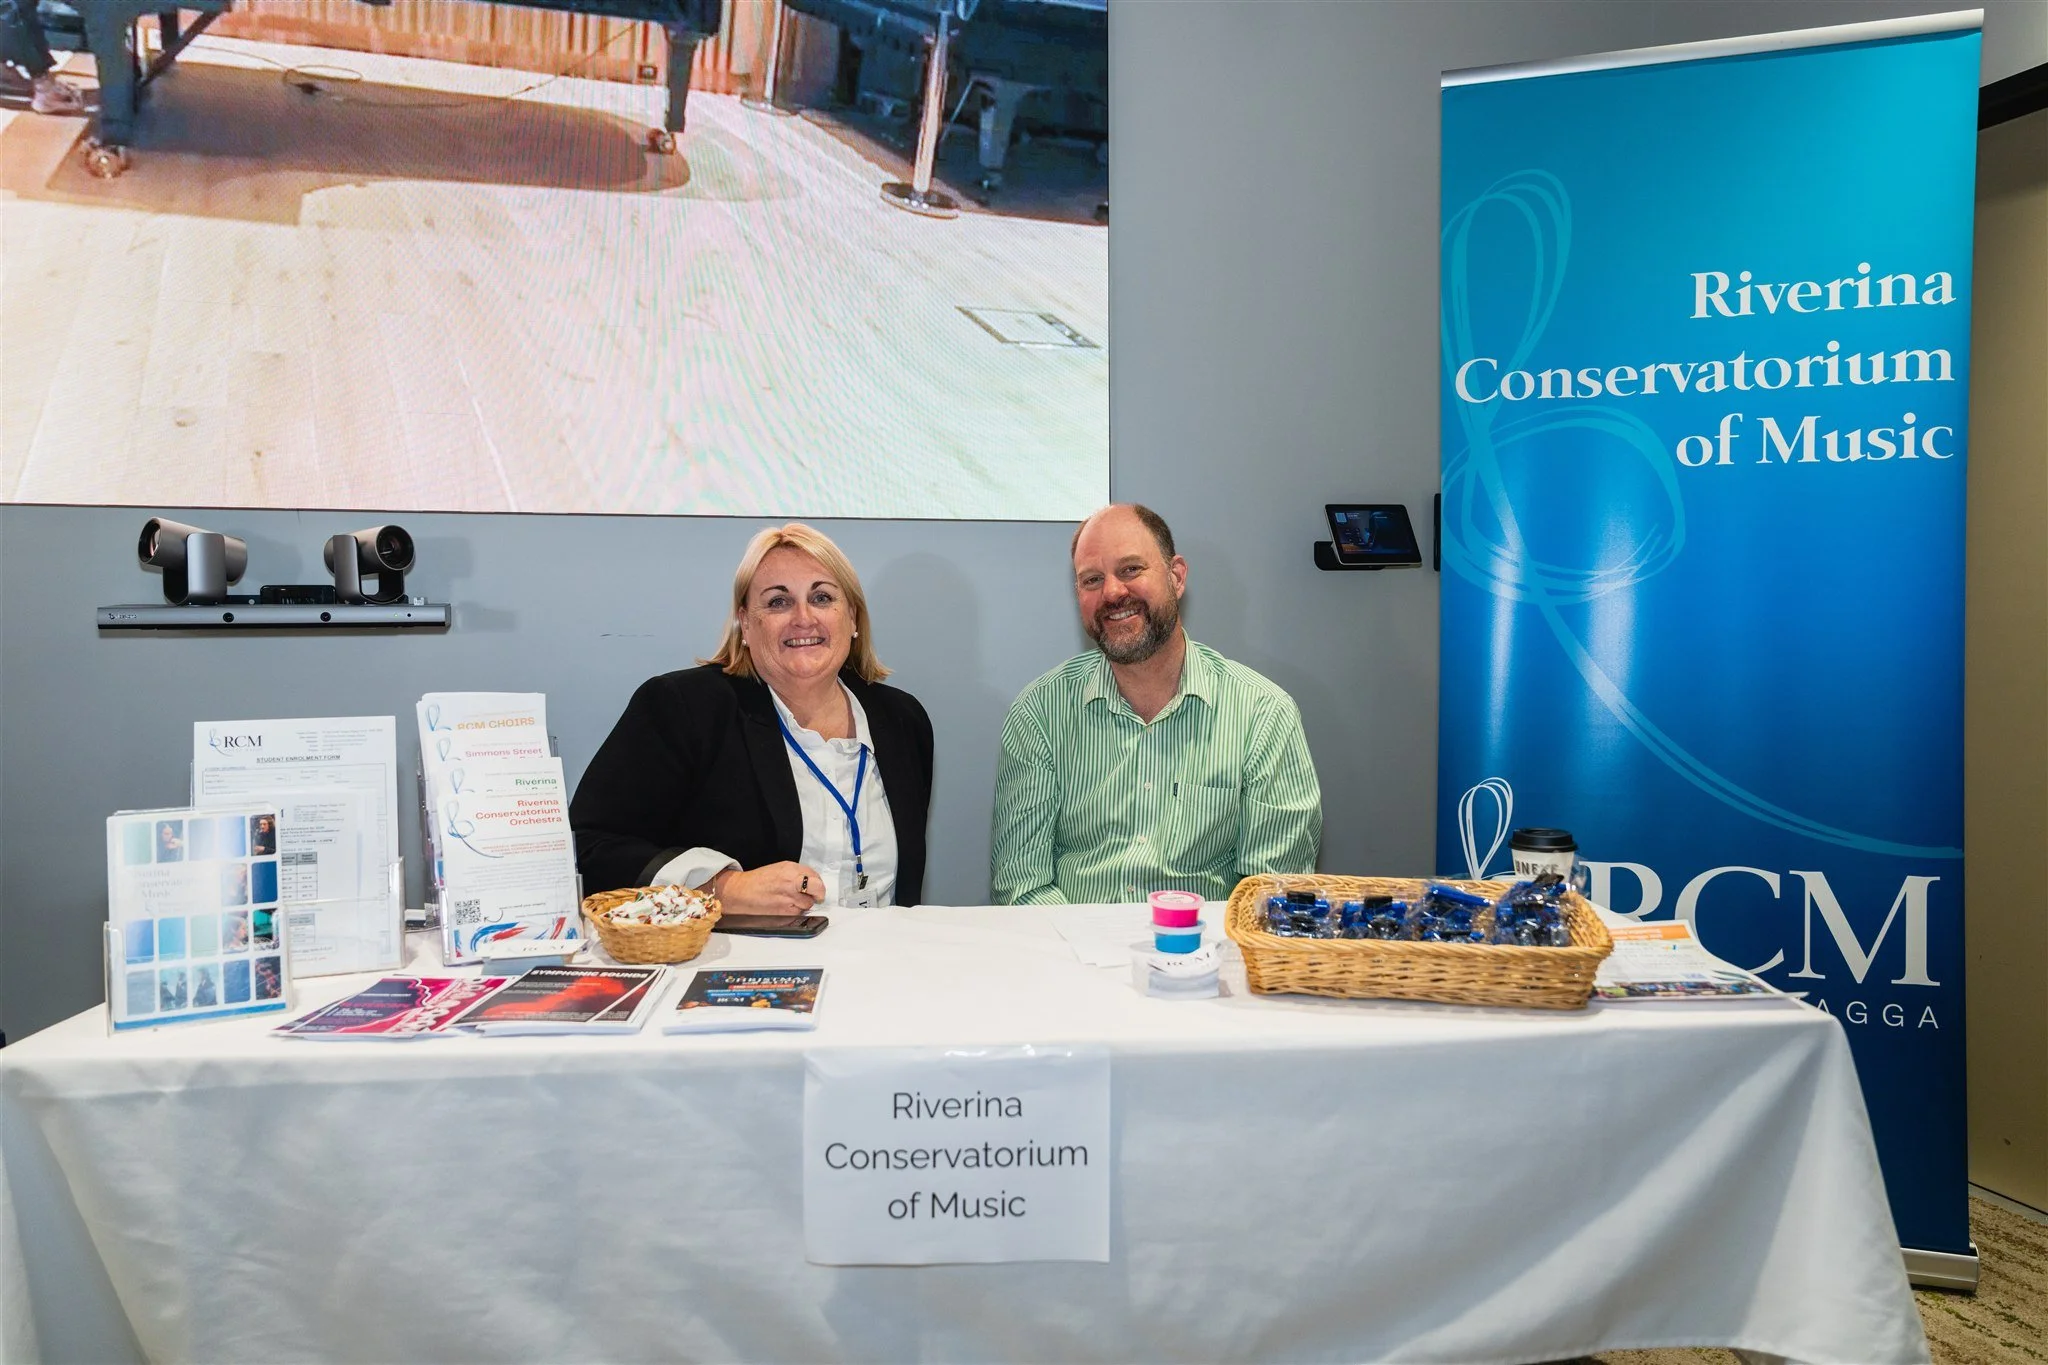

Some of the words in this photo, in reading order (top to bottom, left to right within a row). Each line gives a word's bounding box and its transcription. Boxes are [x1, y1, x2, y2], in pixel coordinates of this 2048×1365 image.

[1690, 262, 1957, 319] Riverina
[1455, 341, 1955, 404] Conservatorium
[1676, 413, 1743, 467] of
[1756, 412, 1954, 465] Music
[457, 721, 486, 730] RCM
[488, 716, 536, 729] CHOIRS
[223, 734, 263, 748] RCM
[465, 749, 511, 758] Simmons
[512, 747, 543, 756] Street
[515, 777, 557, 786] Riverina
[517, 799, 559, 808] Riverina
[475, 808, 561, 820] Conservatorium
[509, 816, 562, 826] Orchestra
[1579, 861, 1941, 987] RCM
[531, 969, 600, 977] SYMPHONIC
[600, 971, 649, 979] SOUNDS
[892, 1090, 1023, 1119] Riverina
[825, 1139, 1088, 1170] Conservatorium
[888, 1191, 922, 1219] of
[931, 1190, 1026, 1219] Music
